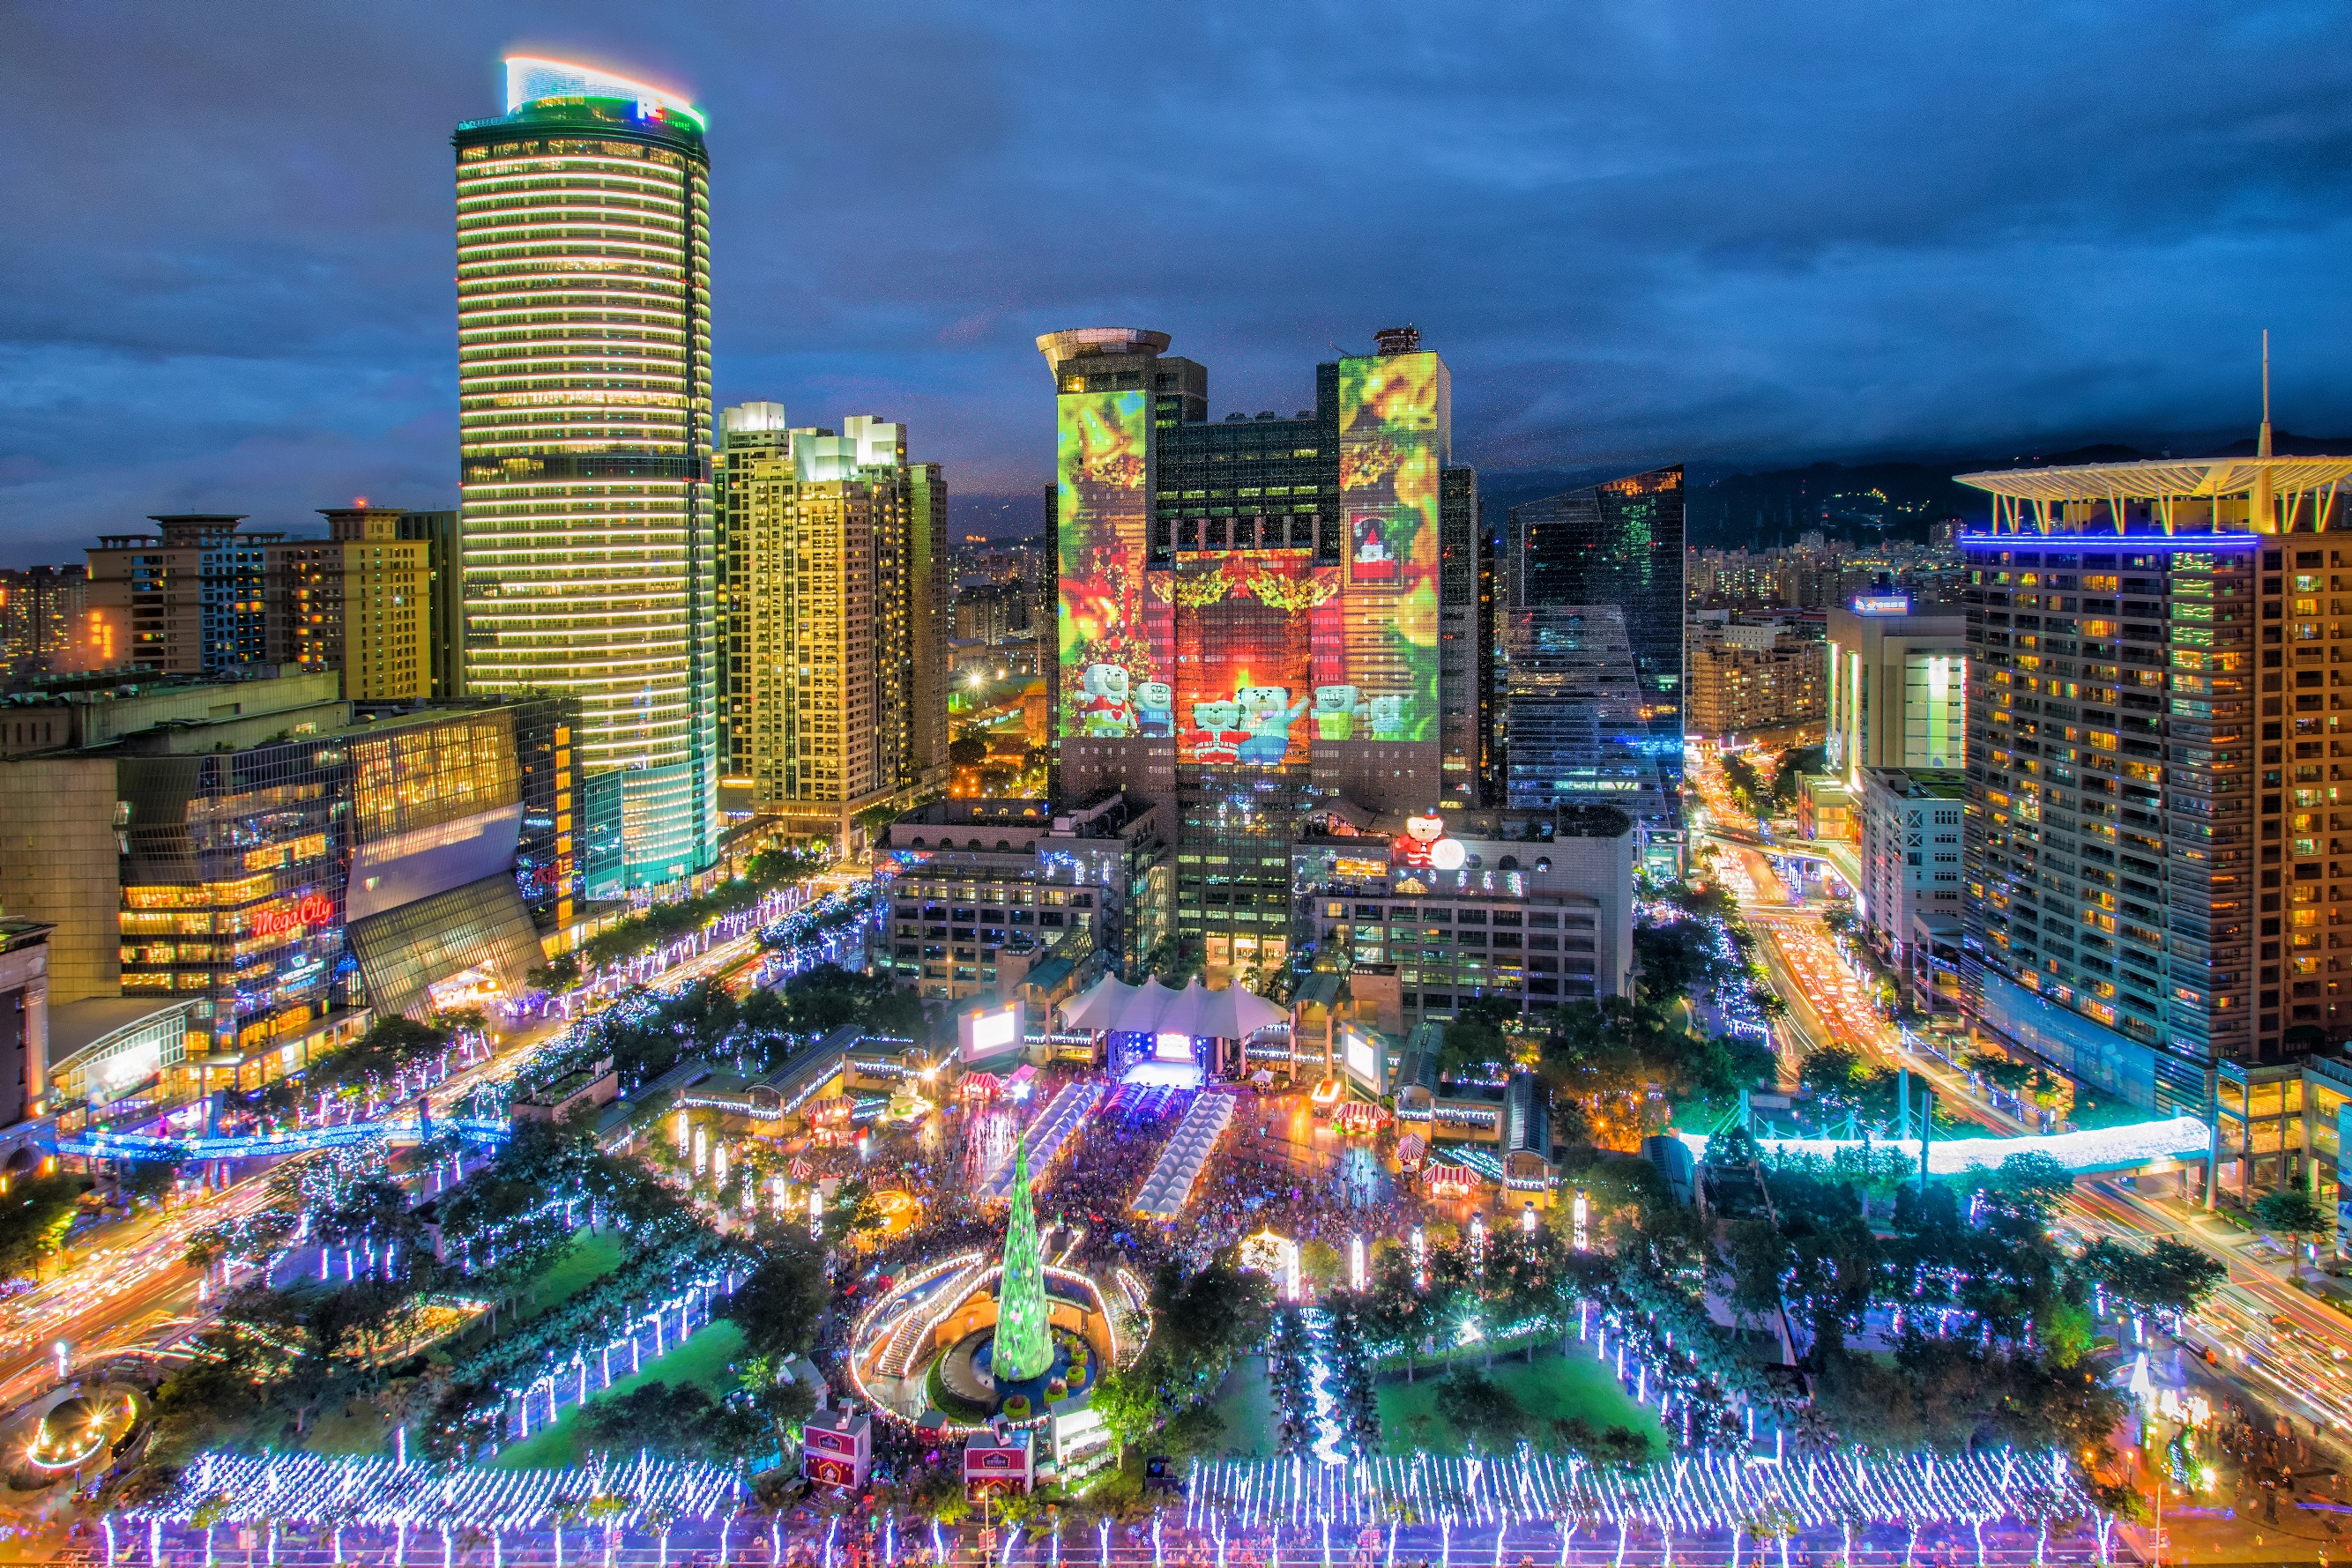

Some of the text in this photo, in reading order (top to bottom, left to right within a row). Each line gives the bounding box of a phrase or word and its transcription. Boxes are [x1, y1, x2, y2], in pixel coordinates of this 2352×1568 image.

[253, 896, 331, 937] Mega City
[286, 976, 317, 992] IMAX
[2045, 1018, 2097, 1054] Chartered
